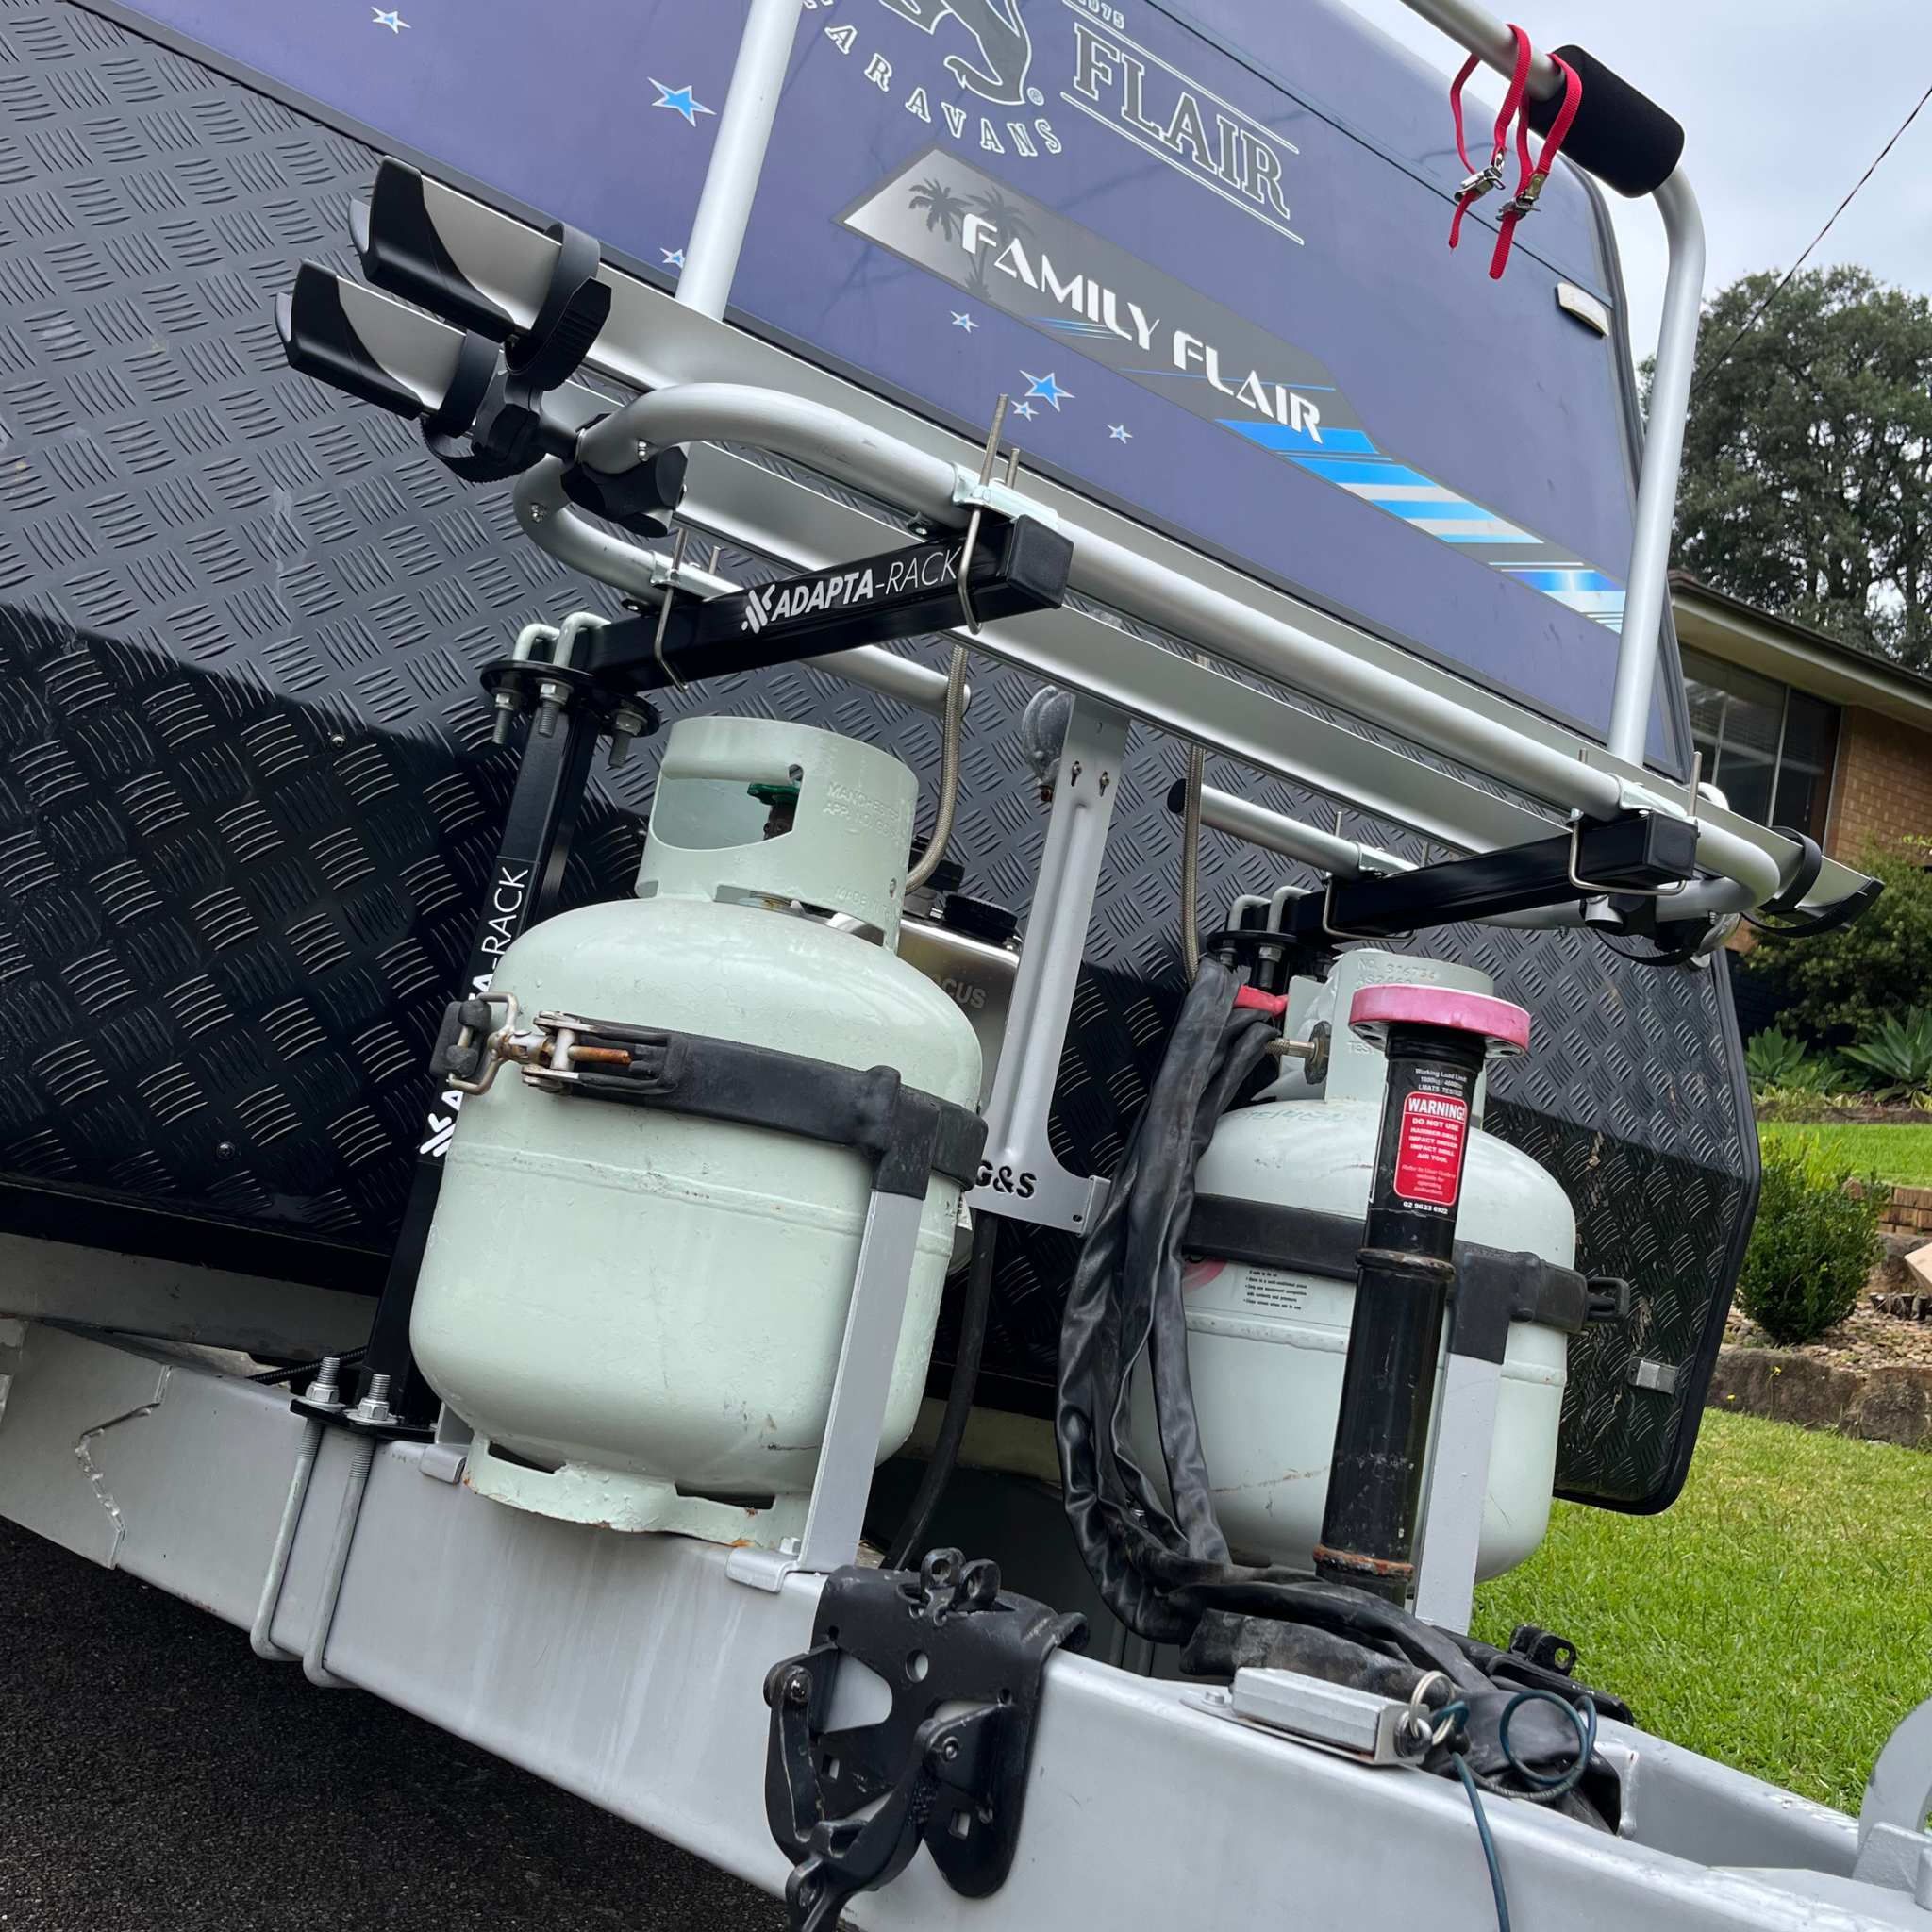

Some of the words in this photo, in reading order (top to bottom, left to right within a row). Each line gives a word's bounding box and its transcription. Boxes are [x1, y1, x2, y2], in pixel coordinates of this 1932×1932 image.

[1073, 22, 1291, 221] FLAIR
[961, 213, 1160, 351] FAMILY
[1172, 329, 1324, 445] FLAIR
[771, 546, 962, 622] ADAPTA-RACK
[1418, 1084, 1440, 1092] LMATS
[1441, 1087, 1463, 1097] TESTED
[1408, 1097, 1465, 1122] WARNING!
[1410, 1126, 1441, 1137] HAMMER
[1412, 1117, 1425, 1125] DO
[1426, 1119, 1444, 1128] NOT
[1445, 1123, 1459, 1132] USE
[1408, 1135, 1435, 1143] IMPACT
[1410, 1143, 1437, 1153] IMPACT
[975, 1159, 1037, 1199] G&S
